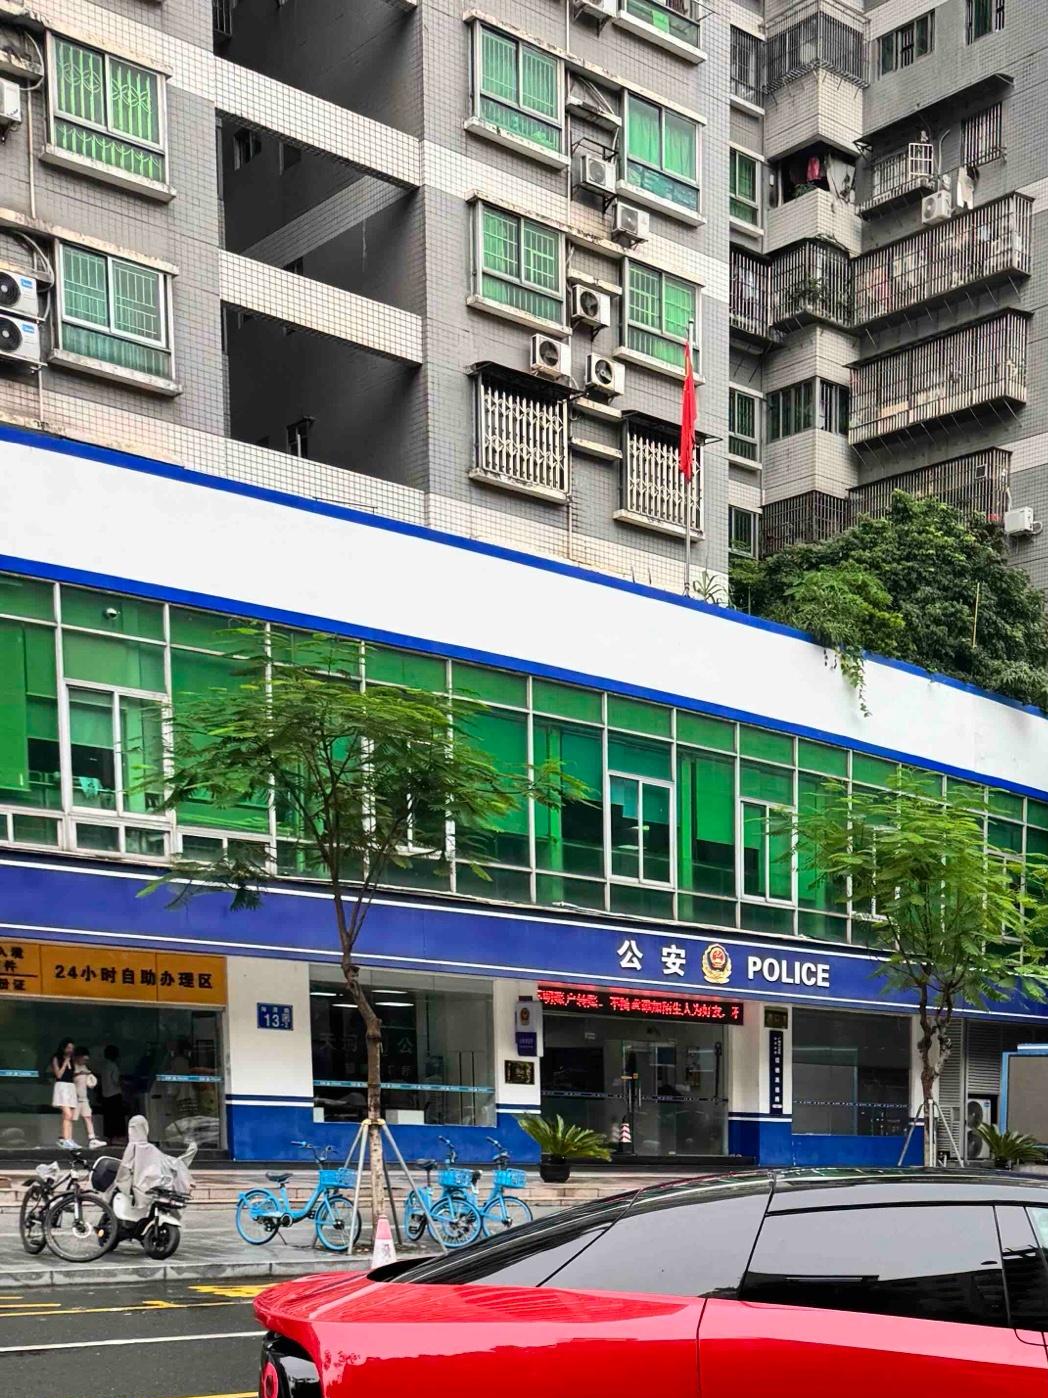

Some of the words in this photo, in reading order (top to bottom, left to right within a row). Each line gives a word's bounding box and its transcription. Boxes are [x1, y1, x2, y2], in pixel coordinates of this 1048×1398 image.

[55, 964, 213, 989] 24小时自助办理区
[617, 940, 687, 977] 公安
[747, 956, 830, 988] POLICE
